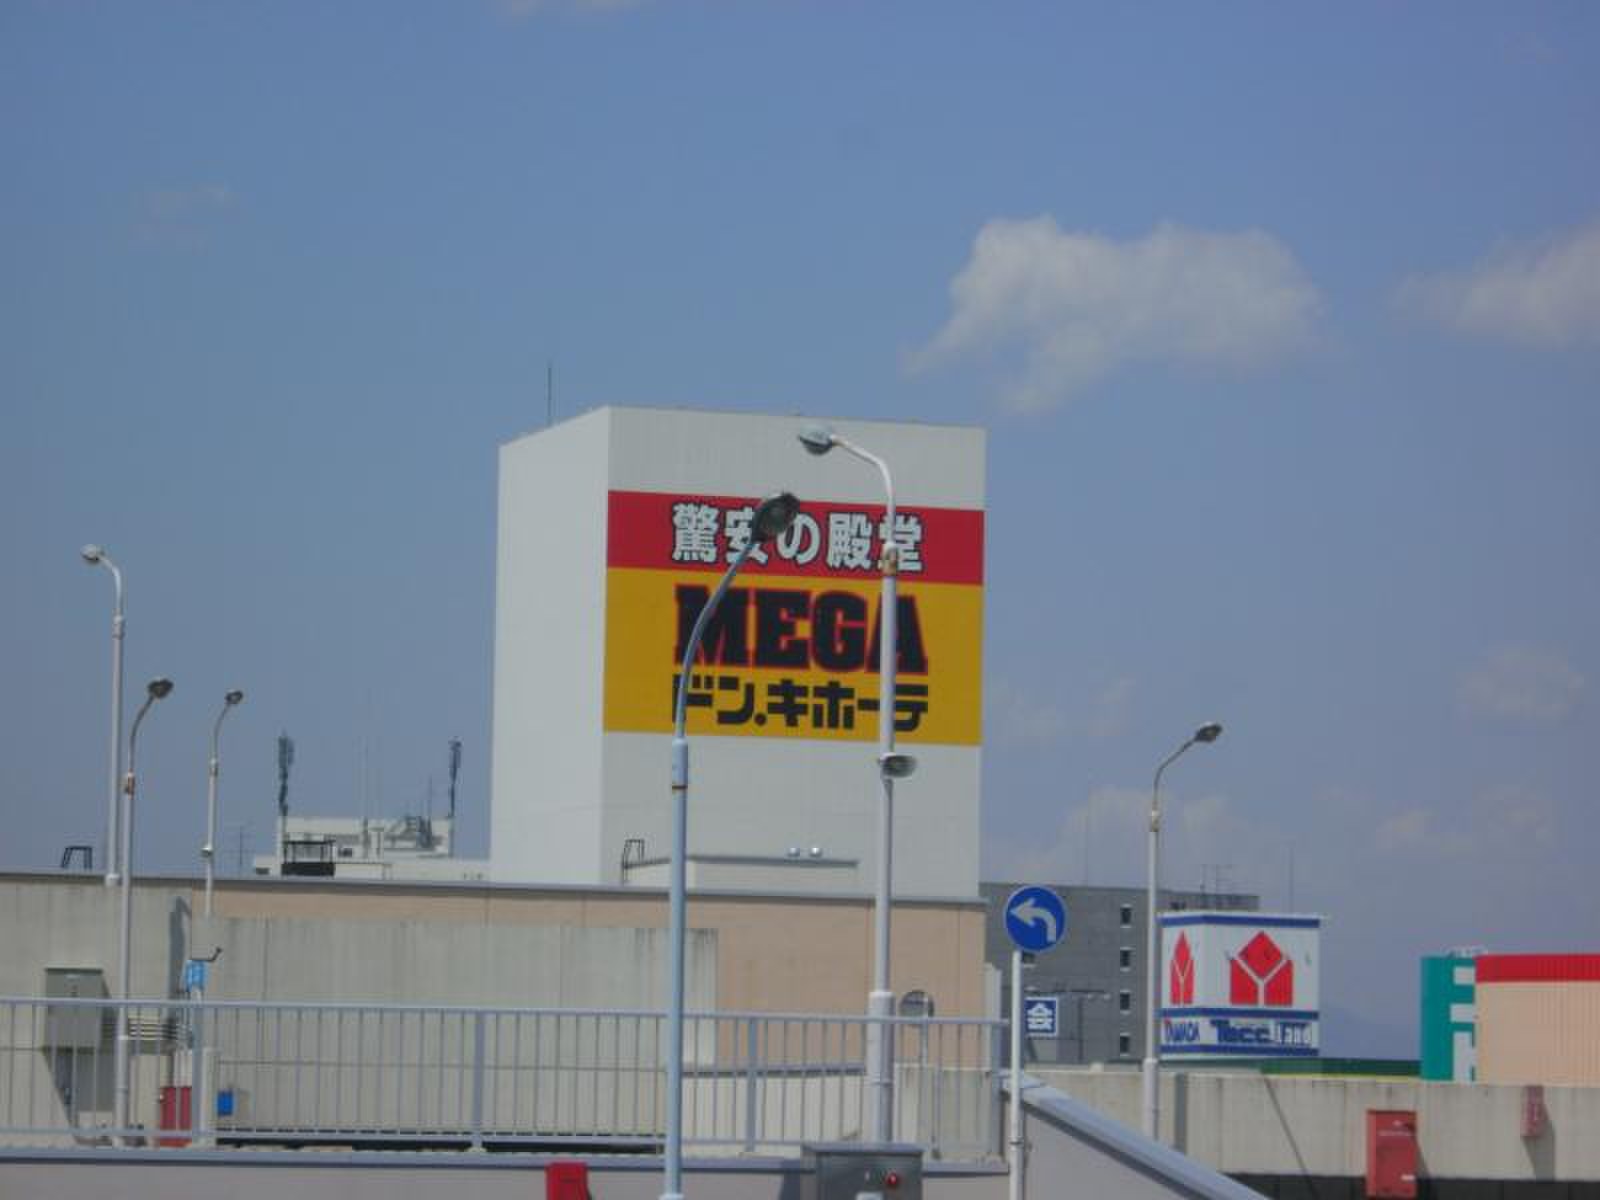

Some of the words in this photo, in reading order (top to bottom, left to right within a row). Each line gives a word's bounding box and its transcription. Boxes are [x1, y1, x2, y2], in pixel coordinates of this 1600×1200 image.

[672, 501, 923, 573] 驚安の殿堂
[672, 583, 929, 676] MEGA
